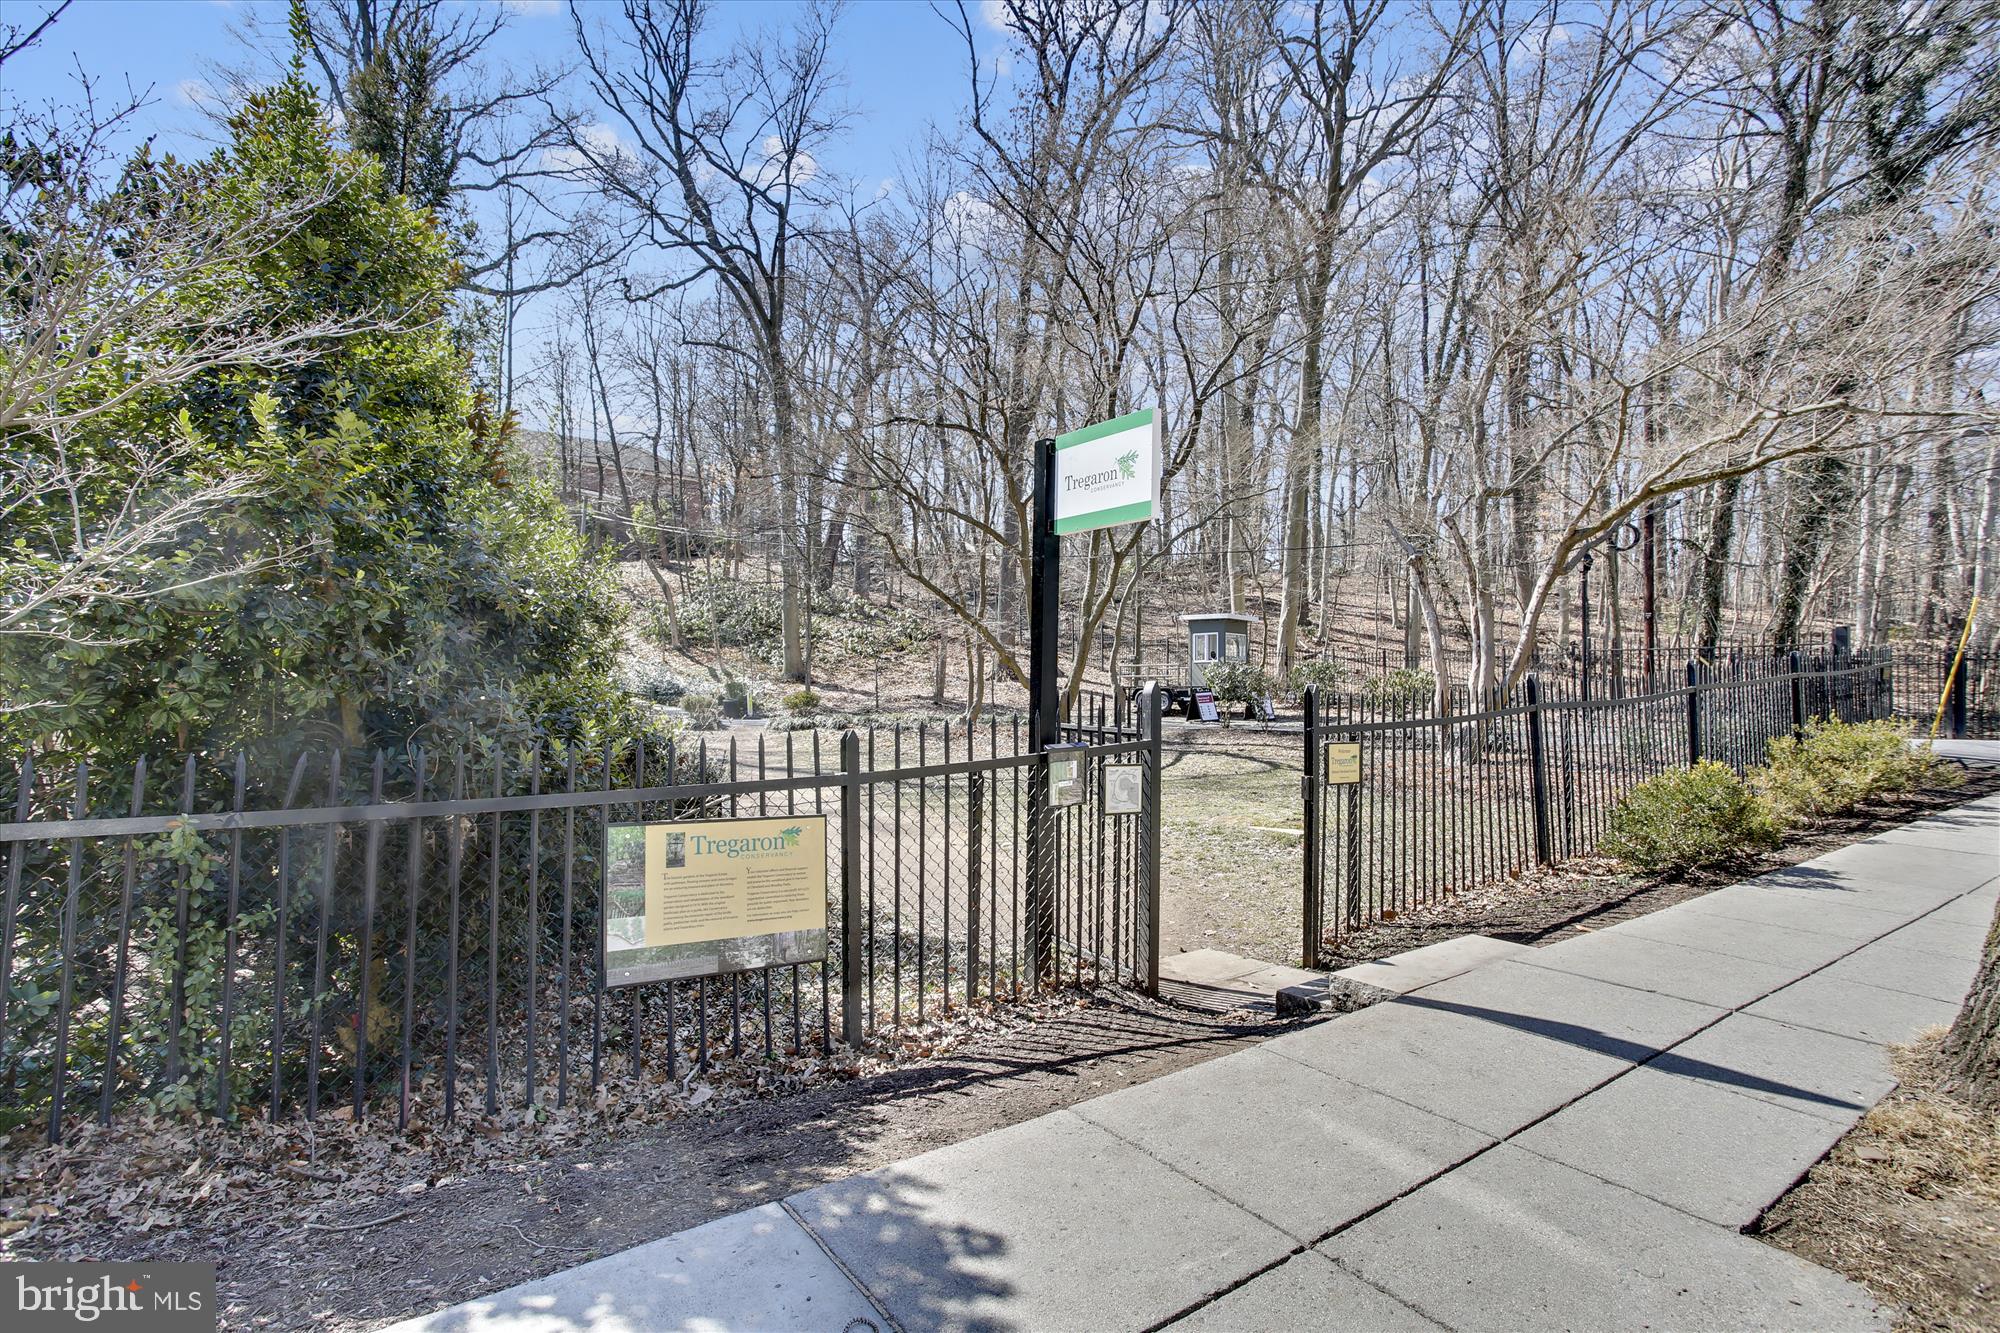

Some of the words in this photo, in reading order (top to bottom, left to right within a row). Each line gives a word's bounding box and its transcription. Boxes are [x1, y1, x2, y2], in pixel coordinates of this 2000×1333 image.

[1065, 469, 1118, 491] Tregaron
[690, 835, 785, 858] Tregaron
[741, 851, 793, 860] CONSERVANCY
